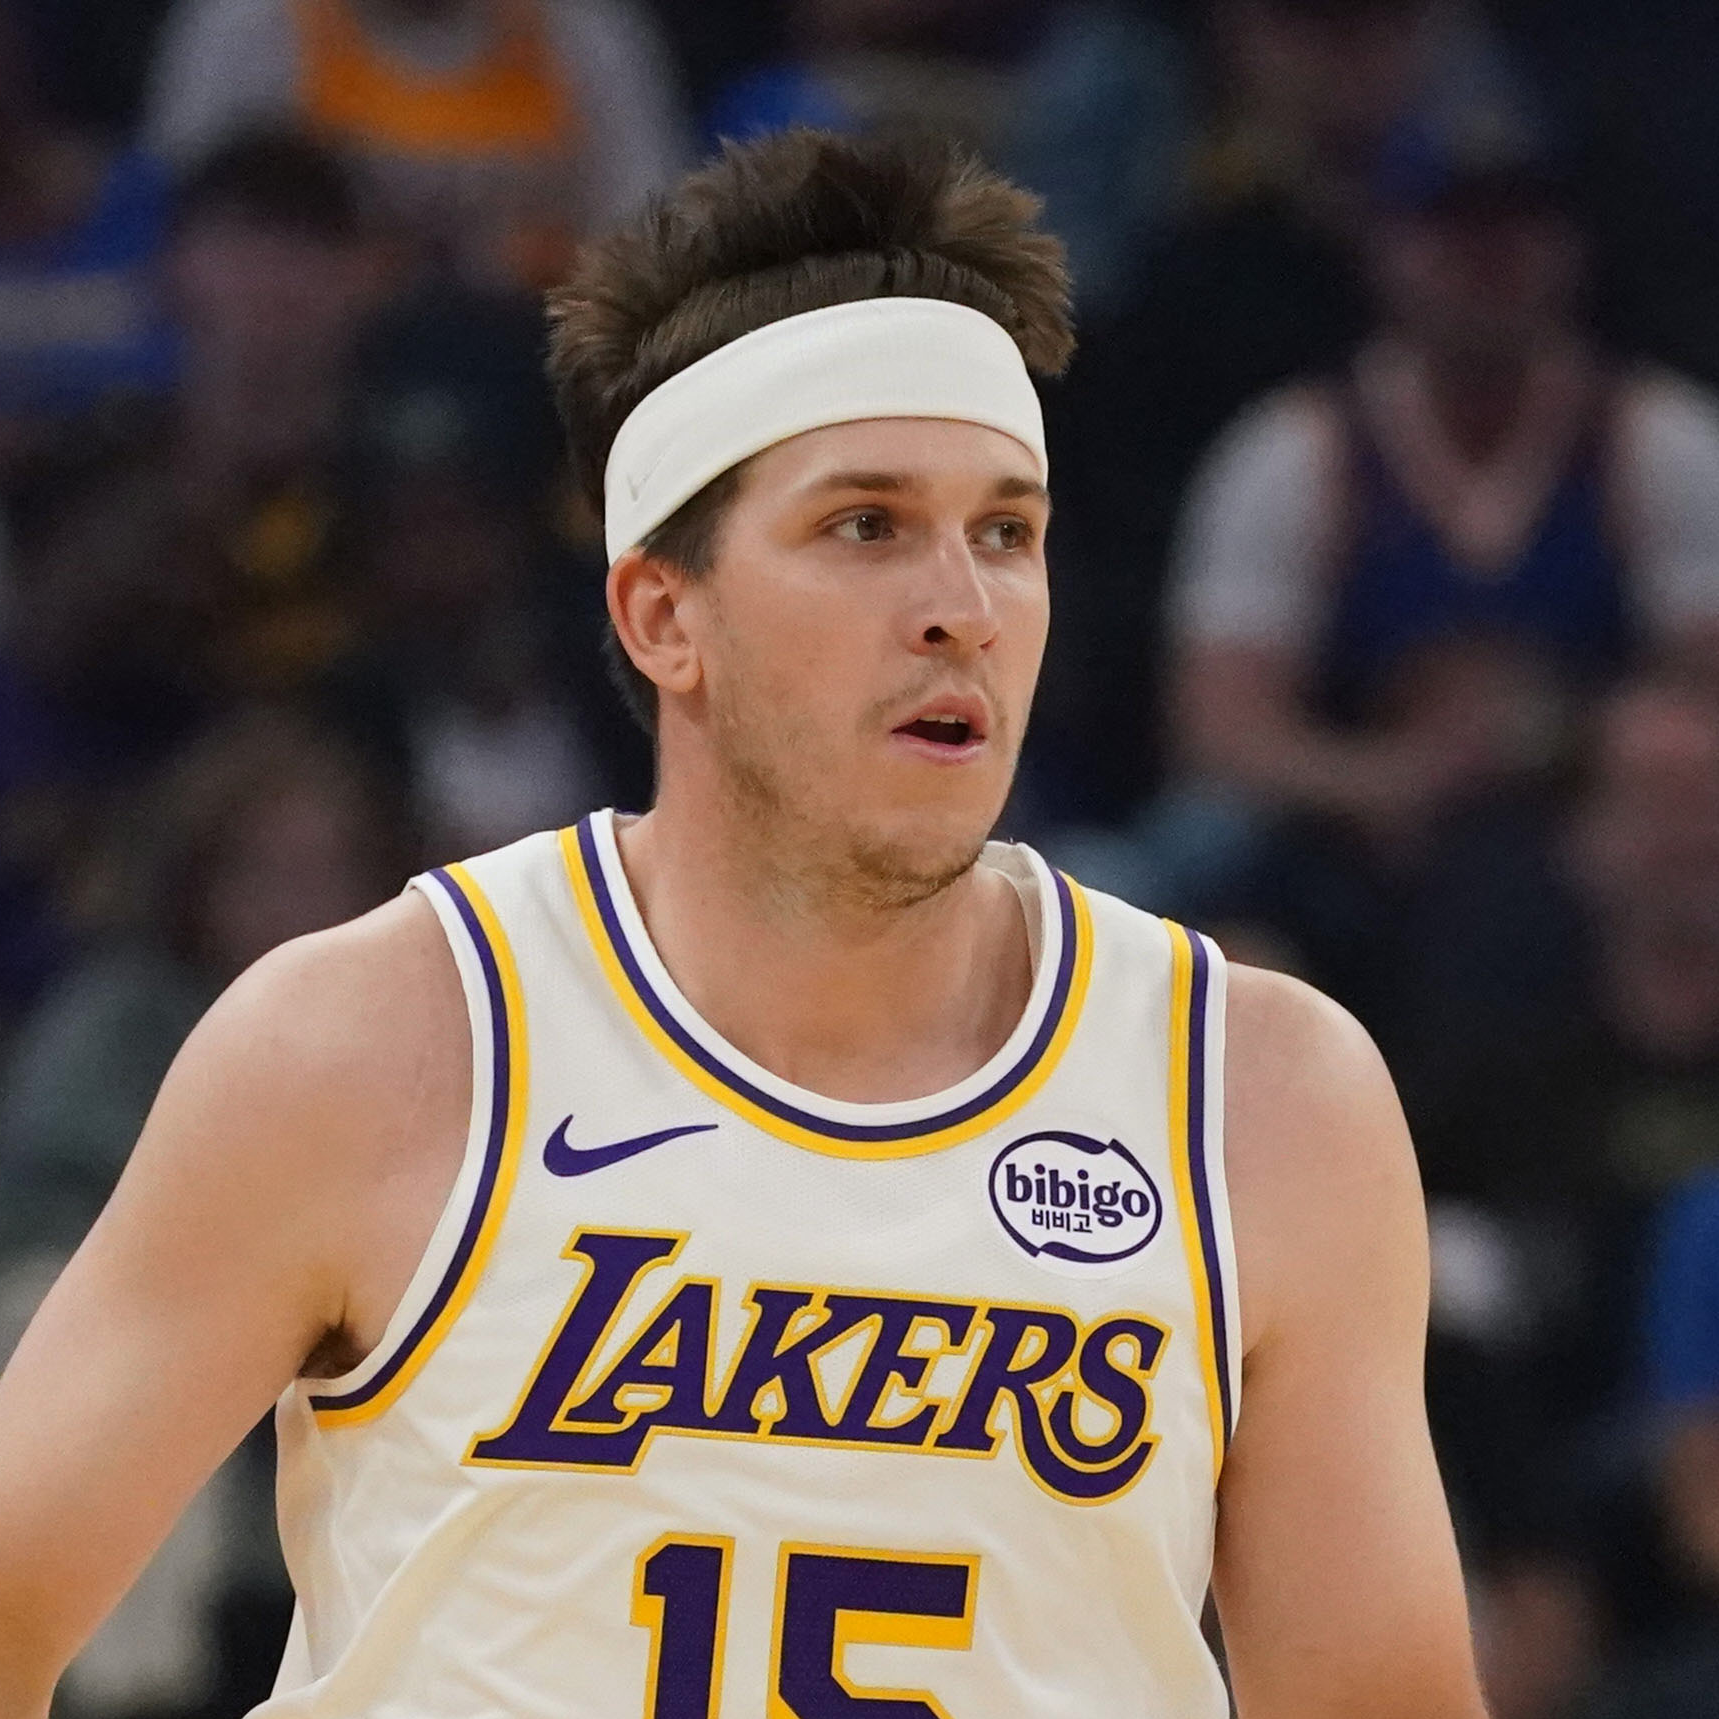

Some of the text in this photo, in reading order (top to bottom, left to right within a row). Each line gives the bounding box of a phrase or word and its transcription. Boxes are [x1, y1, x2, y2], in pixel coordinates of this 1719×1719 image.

[1006, 1163, 1150, 1228] bibigo
[1032, 1208, 1093, 1233] 비비고
[461, 1227, 1172, 1507] LAKERS
